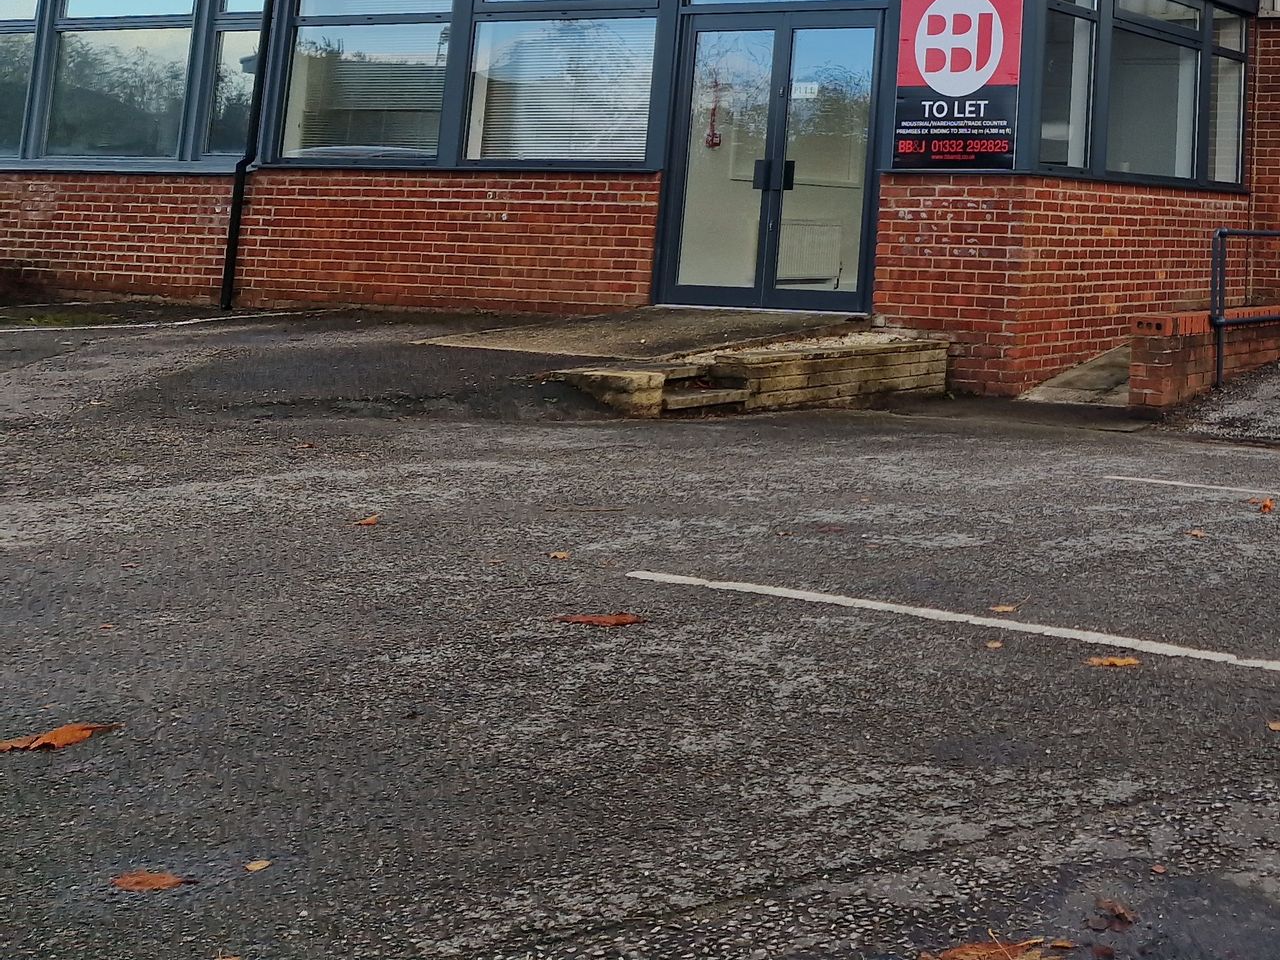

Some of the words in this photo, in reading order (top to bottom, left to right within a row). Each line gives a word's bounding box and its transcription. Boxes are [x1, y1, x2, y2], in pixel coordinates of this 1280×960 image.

[921, 100, 948, 118] TO
[953, 100, 989, 118] LET
[898, 140, 926, 153] BB&J
[931, 140, 964, 152] 01332
[966, 140, 1009, 152] 292825
